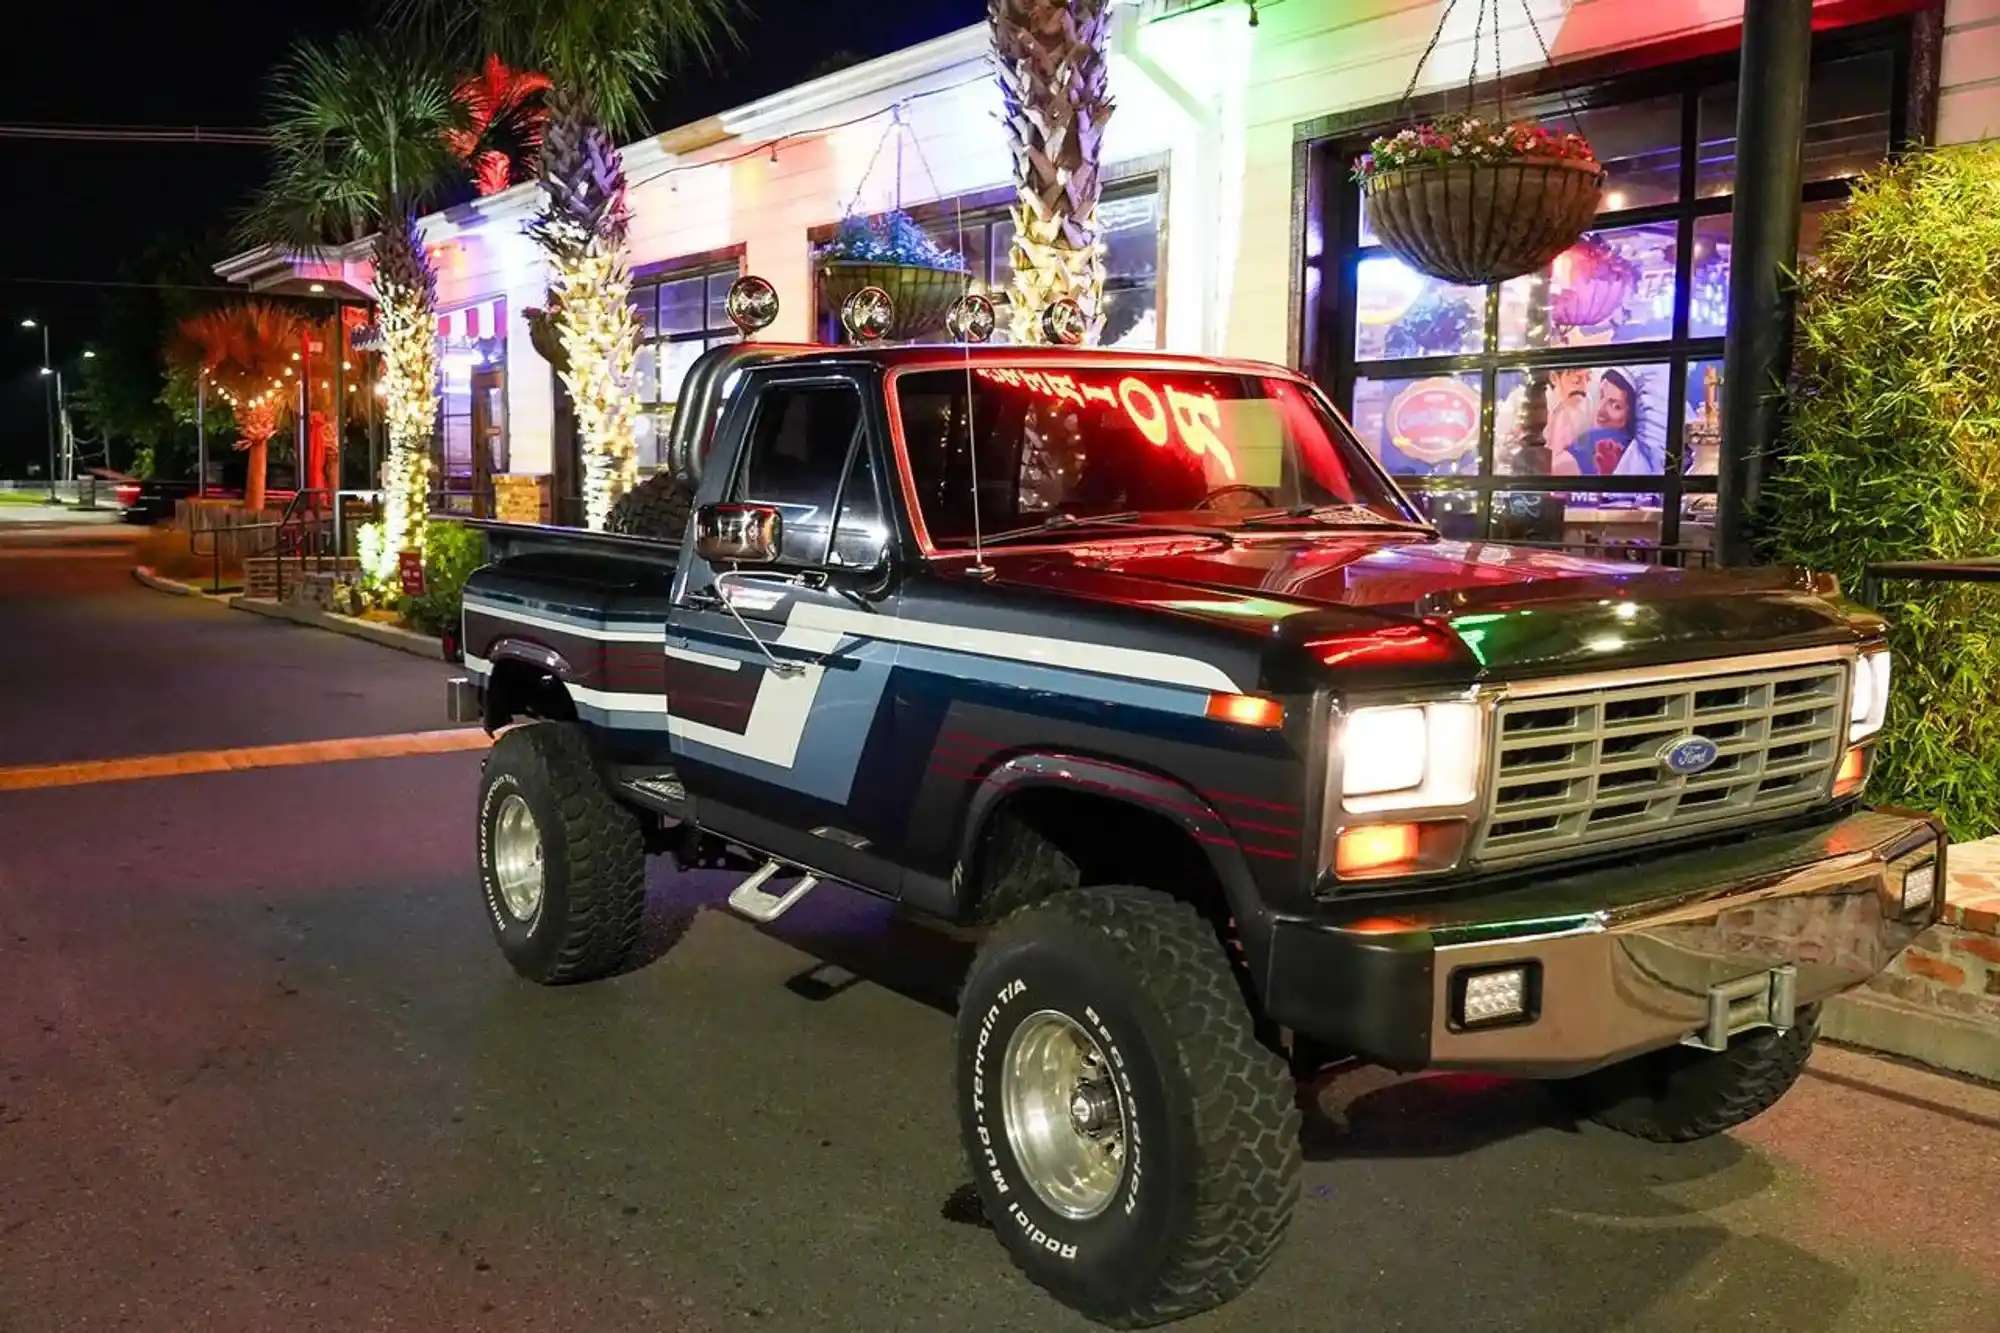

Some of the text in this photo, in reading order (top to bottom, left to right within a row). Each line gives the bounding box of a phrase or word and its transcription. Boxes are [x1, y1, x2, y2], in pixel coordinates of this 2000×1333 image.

[1679, 744, 1708, 766] Ford
[973, 978, 1077, 1260] Radial Mud-Terrain T/A
